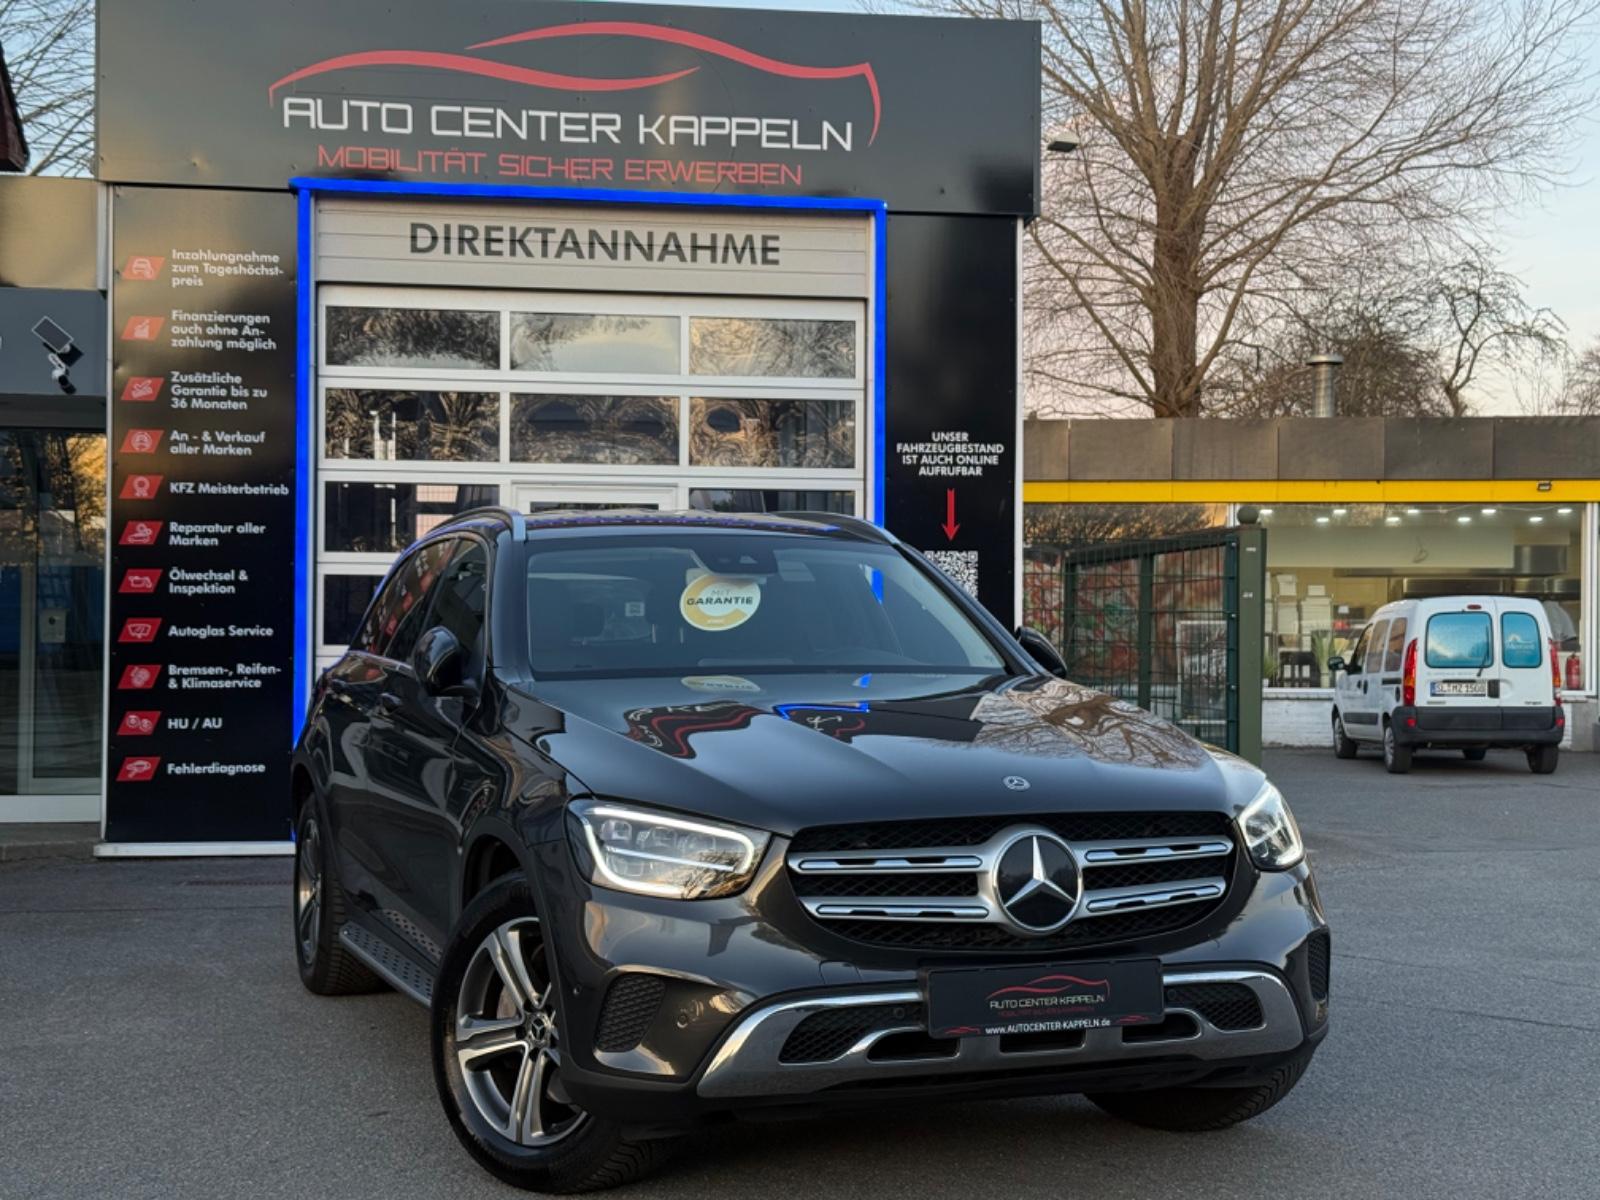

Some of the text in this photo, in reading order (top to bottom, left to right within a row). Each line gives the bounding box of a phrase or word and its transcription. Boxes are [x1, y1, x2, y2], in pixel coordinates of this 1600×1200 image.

[283, 97, 852, 152] AUTO CENTER KAPPELN
[318, 145, 803, 186] MOBILITÄT SICHER ERWERBEN
[409, 222, 781, 267] DIREKTANNAHME
[171, 249, 281, 266] Inzahlungnahme
[171, 262, 284, 277] zum Tageshöchst-
[171, 276, 204, 288] preis
[171, 310, 271, 326] Finanzierungen
[171, 324, 265, 337] auch ohne An-
[171, 337, 277, 351] zahlung möglich
[170, 371, 243, 384] Zusätzliche
[171, 385, 268, 398] Garantie bis zu
[171, 398, 248, 410] 36 Monaten
[170, 431, 189, 442] An
[202, 431, 211, 443] &
[215, 431, 265, 444] Verkauf
[931, 432, 969, 442] UNSER
[170, 444, 252, 456] aller Marken
[896, 443, 1004, 454] FAHRZEUGBESTAND
[902, 454, 998, 465] IST AUCH ONLINE
[918, 466, 982, 476] AUFRUFBAR
[170, 483, 290, 496] KFZ Meisterbetrieb
[169, 522, 266, 536] Reparatur aller
[169, 535, 219, 546] Marken
[169, 567, 249, 581] Ölwechsel &
[169, 583, 236, 596] Inspektion
[686, 596, 754, 606] GARANTIE
[168, 625, 274, 638] Autoglas Service
[168, 664, 282, 677] Bremsen-, Reifen-
[168, 677, 262, 689] & Klimaservice
[168, 717, 223, 730] HU / AU
[167, 763, 266, 776] Fehlerdiagnose
[989, 994, 1105, 1009] AUTO CENTER KAPPELN
